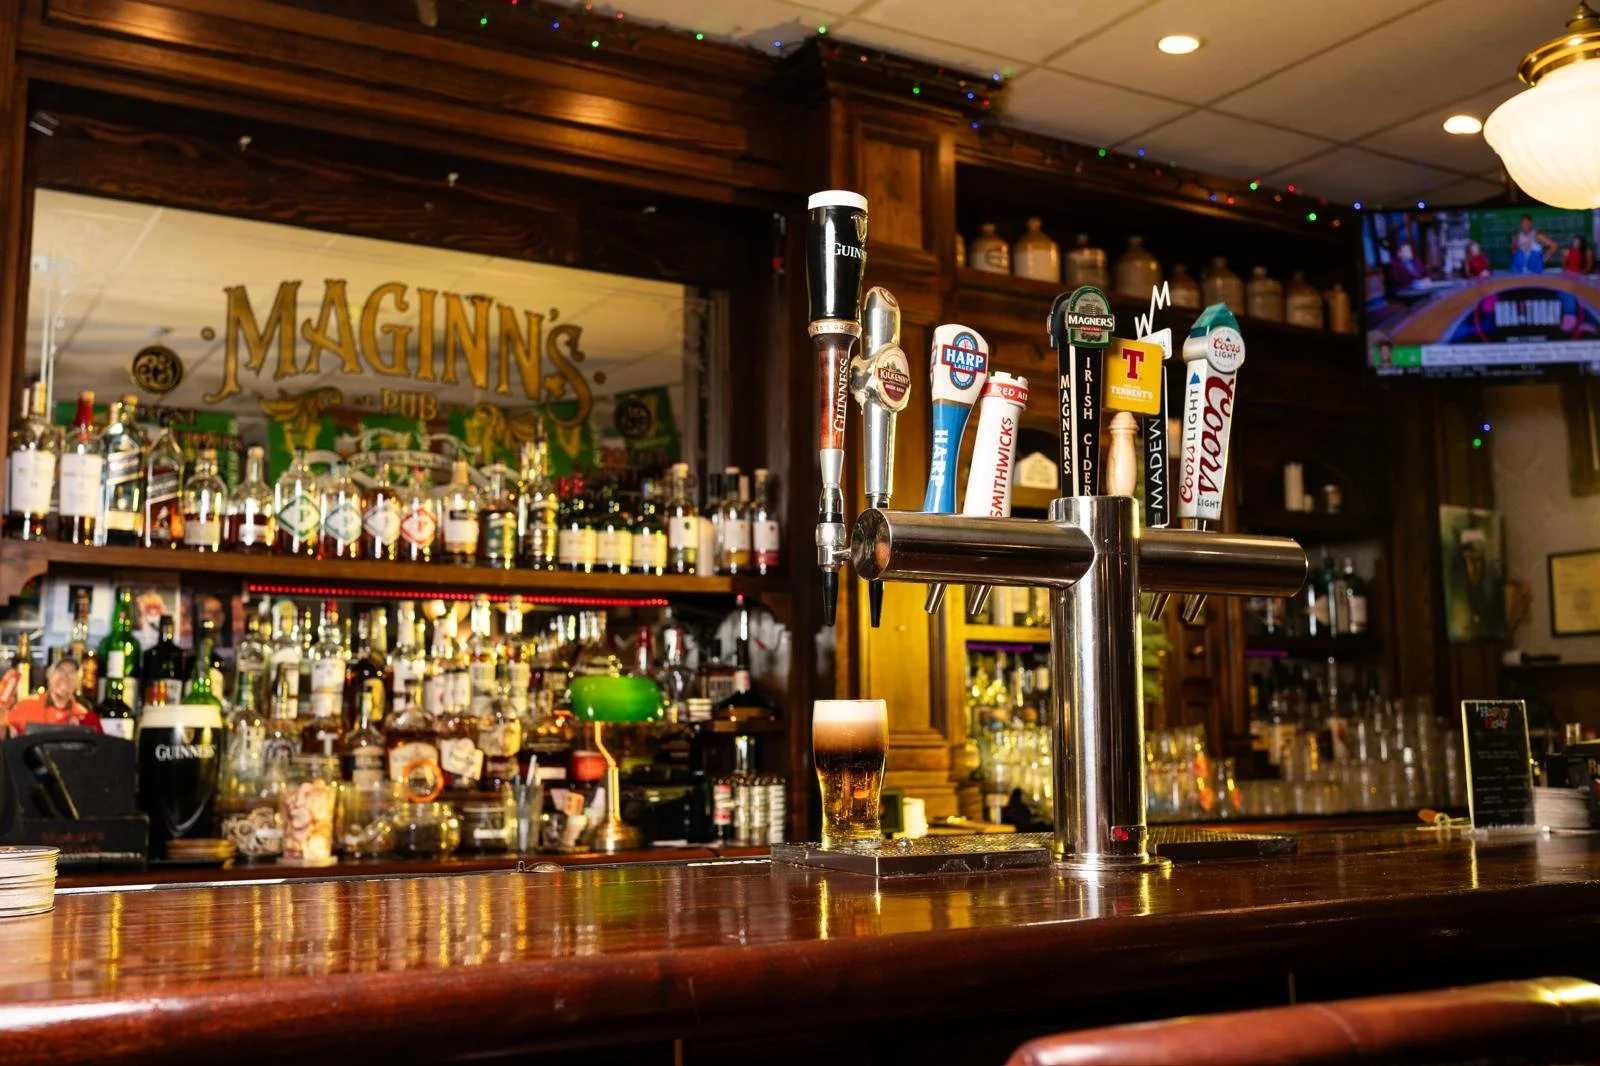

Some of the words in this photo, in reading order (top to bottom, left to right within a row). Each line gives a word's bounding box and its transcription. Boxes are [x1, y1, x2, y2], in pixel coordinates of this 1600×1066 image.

[1068, 315, 1113, 328] MAGNERS
[1213, 336, 1241, 353] Coors
[202, 279, 593, 428] MAGINN'S
[946, 348, 985, 368] HARP
[954, 364, 974, 372] LAGER
[1122, 347, 1145, 380] T
[1214, 351, 1237, 360] LIGHT
[382, 388, 438, 421] PUB
[833, 358, 849, 432] GUINNESS
[1083, 357, 1093, 420] IRISH
[1060, 374, 1071, 474] MAGNERS
[1187, 389, 1199, 441] LIGHT
[1198, 376, 1234, 496] Coors
[931, 429, 948, 488] HARP
[1083, 433, 1093, 497] CIDER
[1180, 445, 1196, 503] Coors
[1197, 499, 1220, 509] LIGHT
